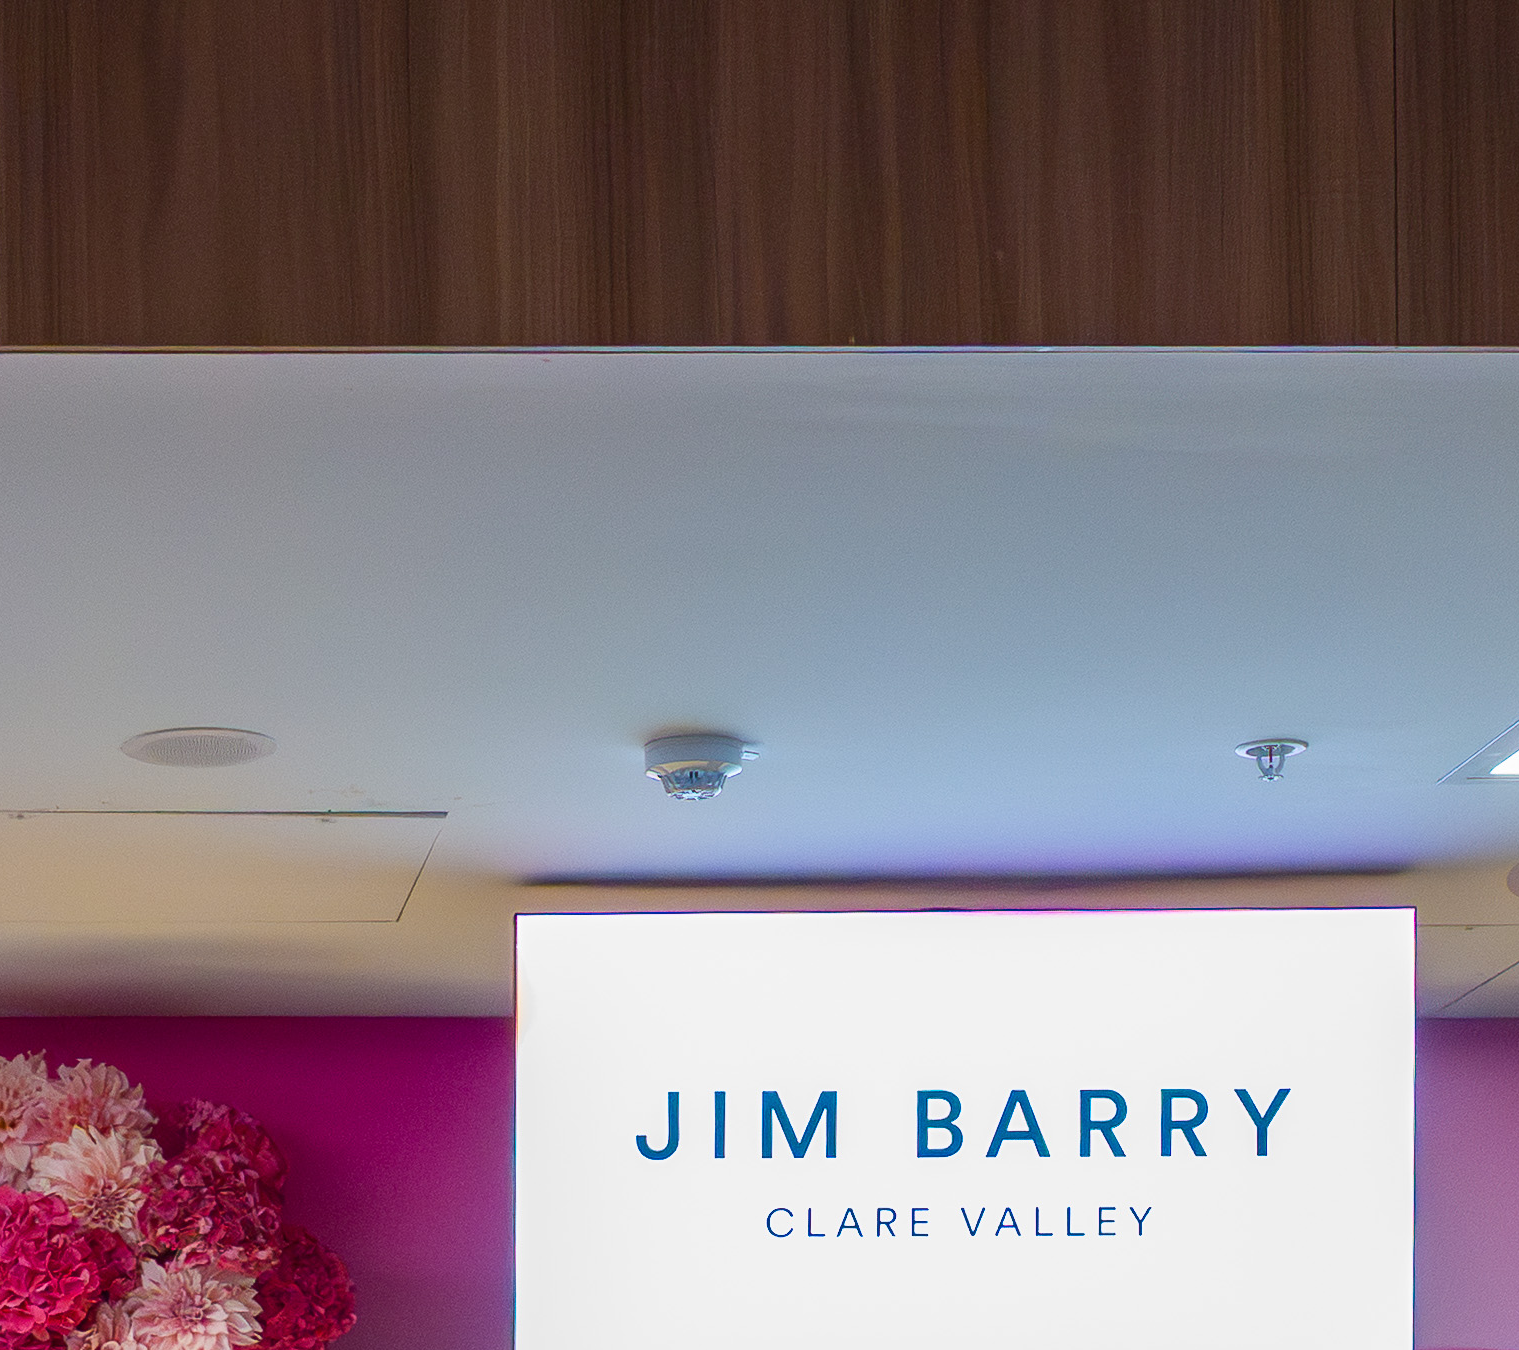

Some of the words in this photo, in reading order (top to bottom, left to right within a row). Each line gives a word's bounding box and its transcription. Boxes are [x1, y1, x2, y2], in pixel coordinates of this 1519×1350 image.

[636, 1090, 838, 1161] JIM
[915, 1087, 1291, 1159] BARRY
[766, 1207, 931, 1238] CLARE
[960, 1206, 1153, 1237] VALLEY
